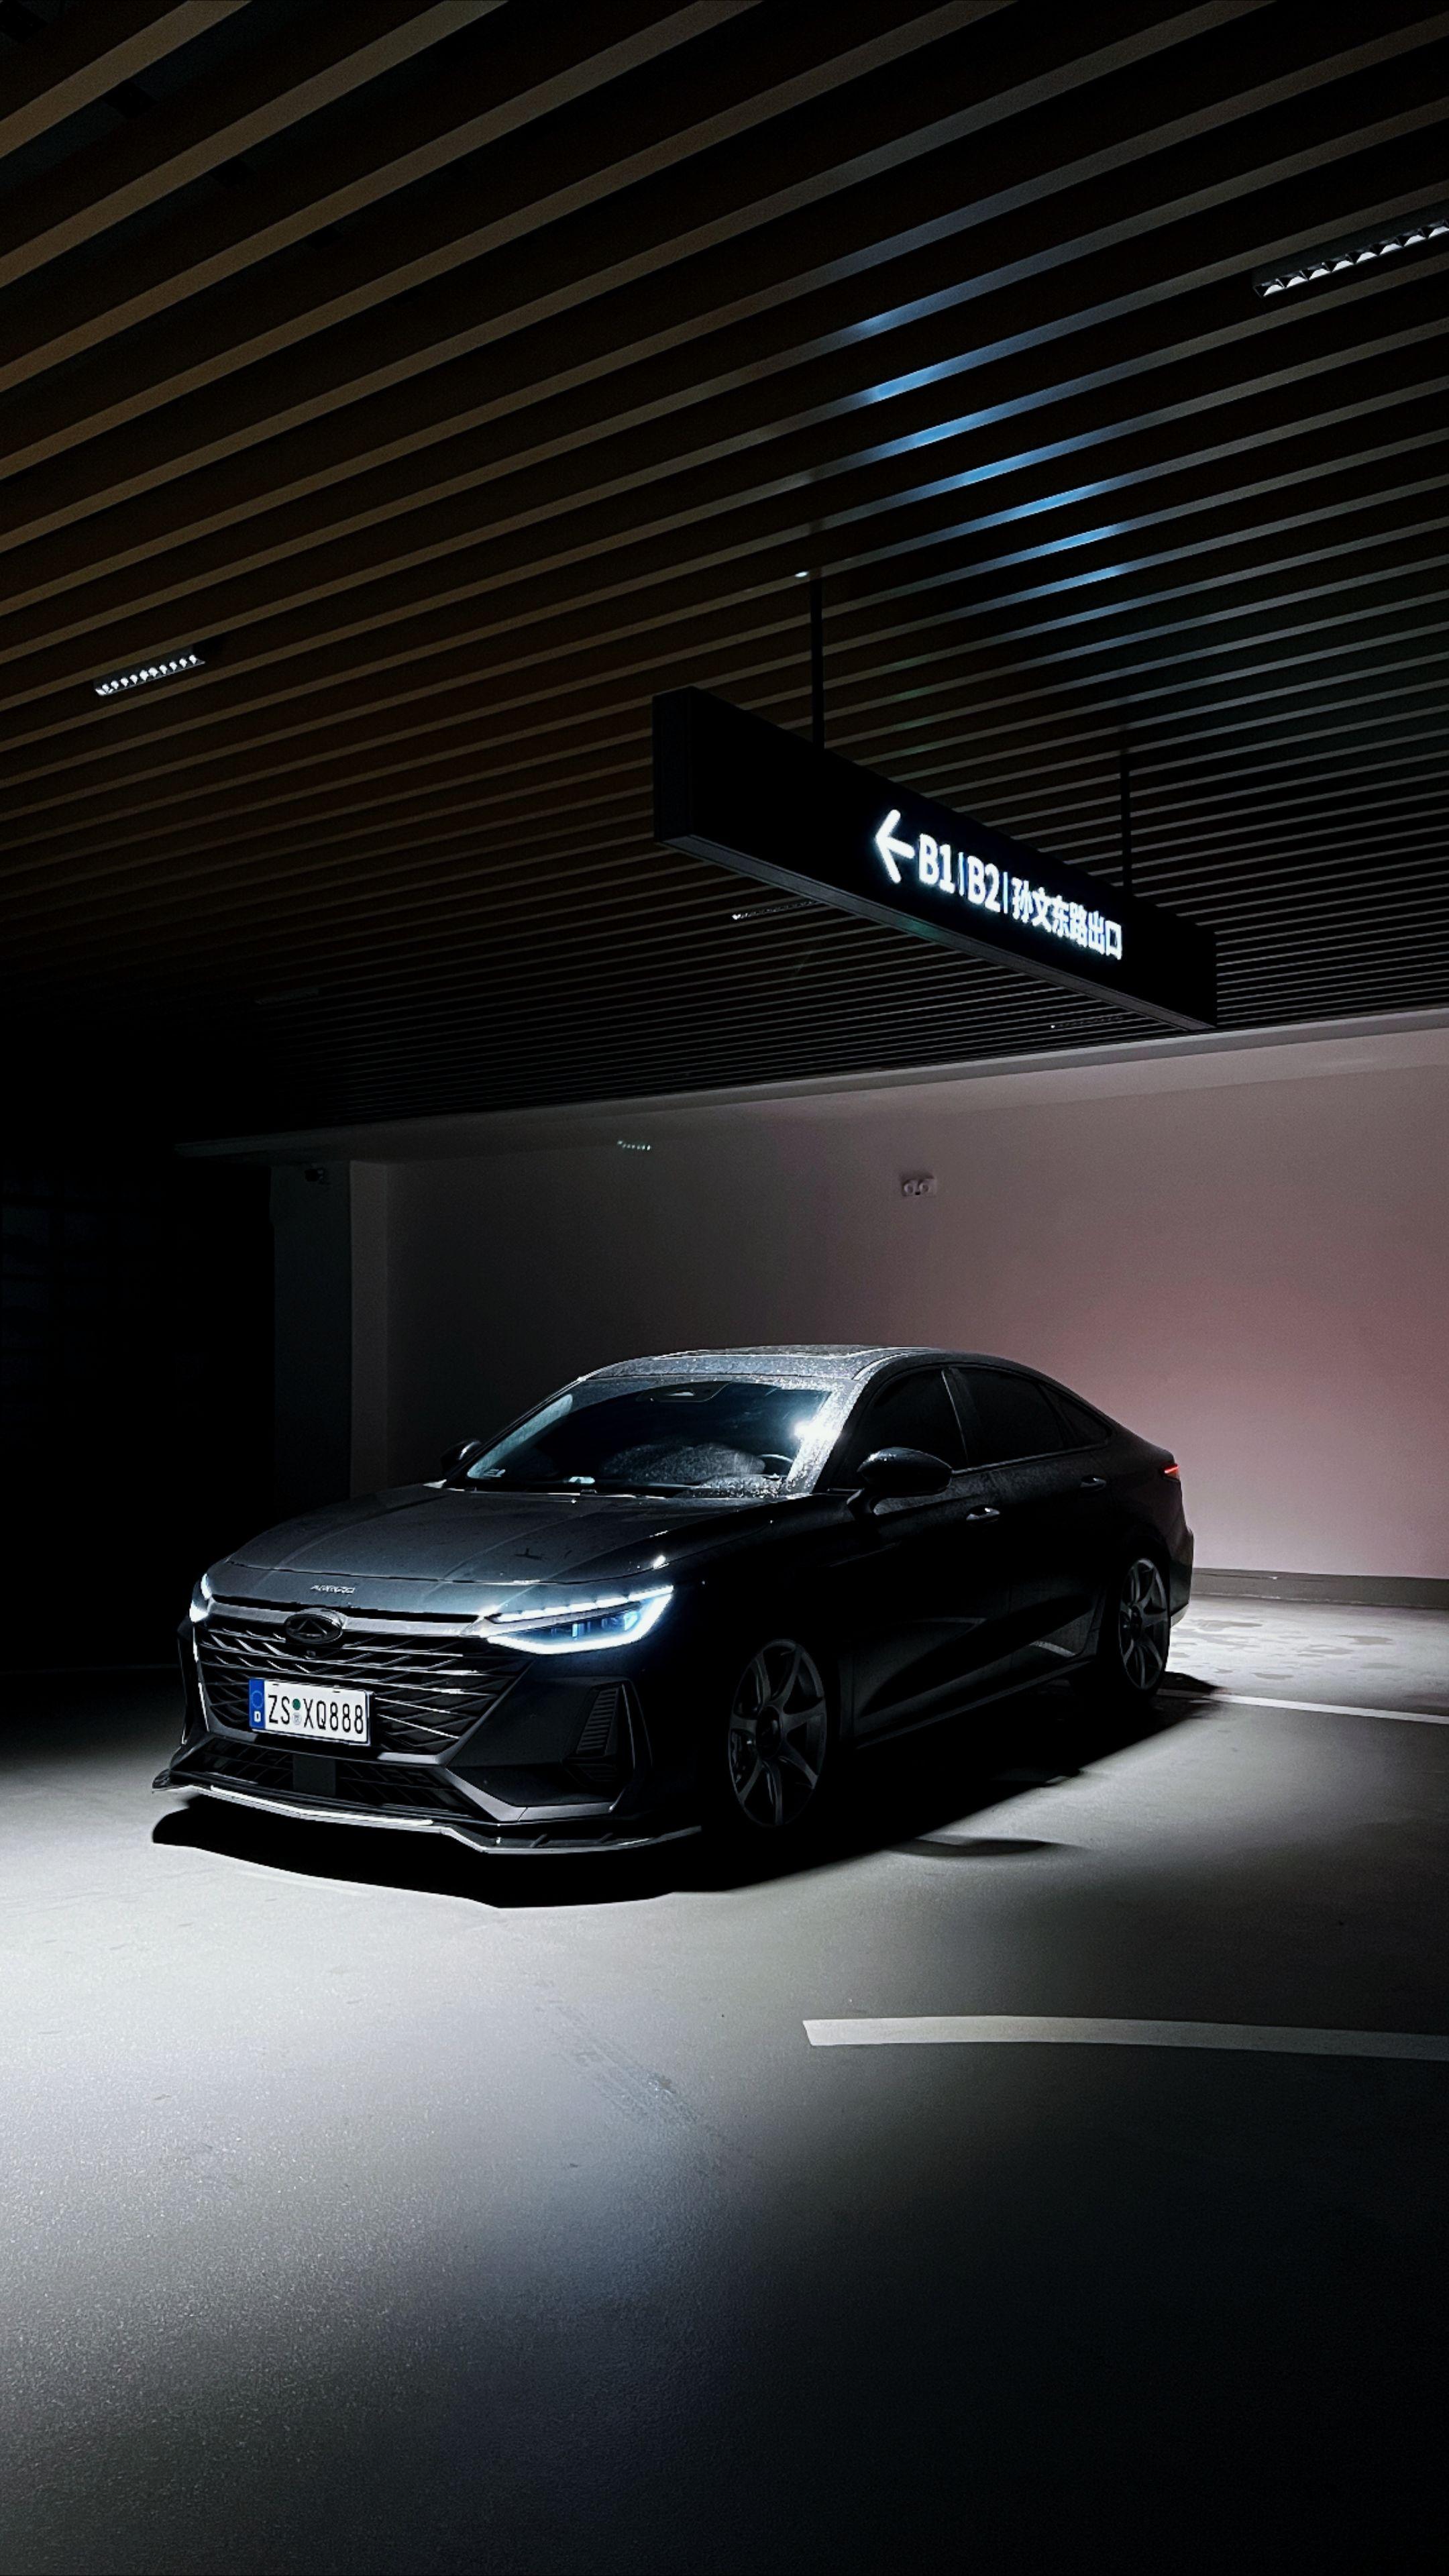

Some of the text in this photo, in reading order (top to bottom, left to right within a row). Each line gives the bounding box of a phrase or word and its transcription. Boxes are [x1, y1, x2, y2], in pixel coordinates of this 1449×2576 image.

[918, 833, 955, 894] B1
[967, 855, 1001, 913] B2
[268, 1695, 290, 1725] ZS
[303, 1698, 364, 1735] XQ888
